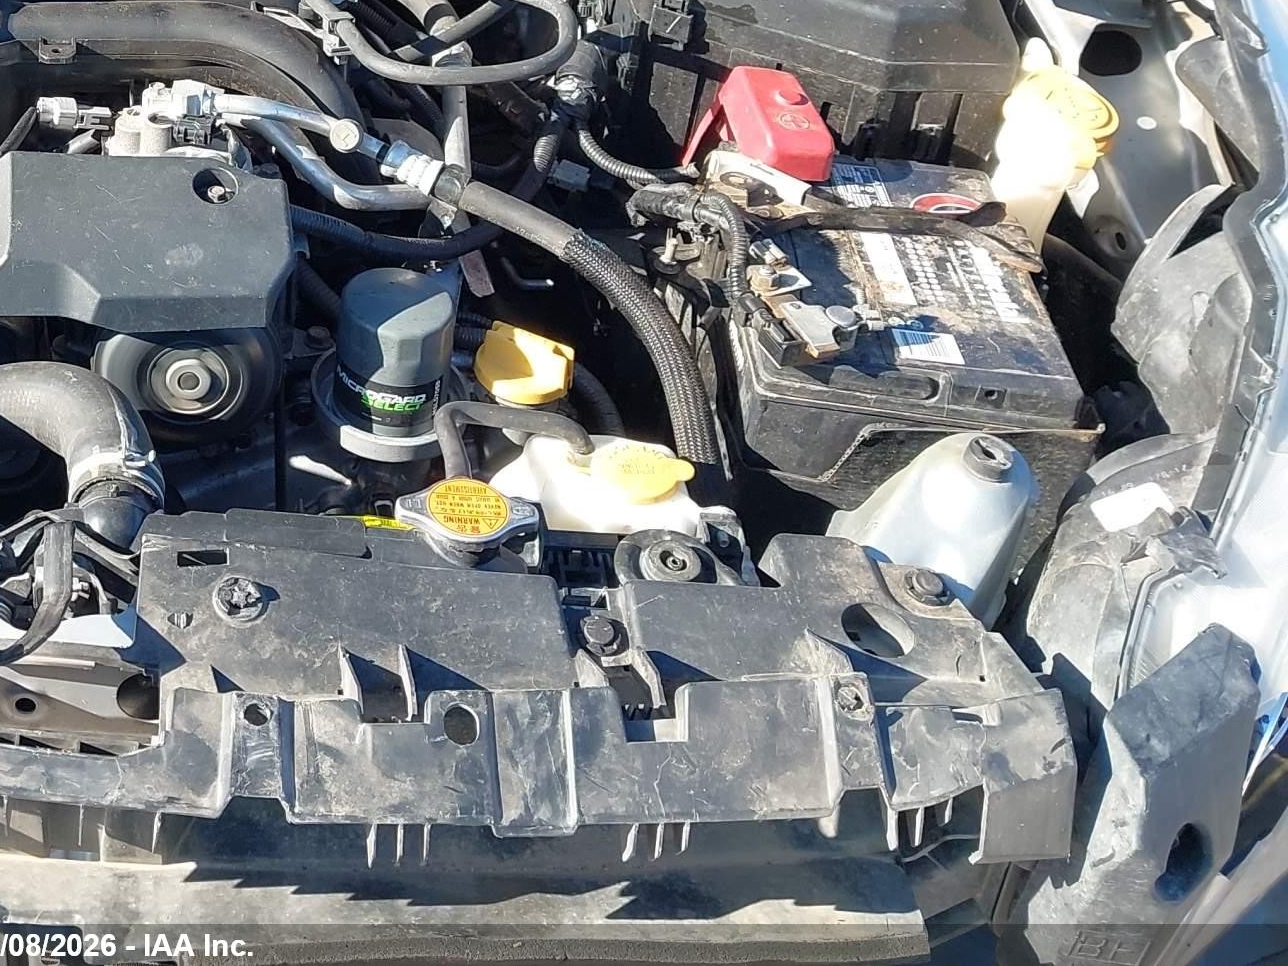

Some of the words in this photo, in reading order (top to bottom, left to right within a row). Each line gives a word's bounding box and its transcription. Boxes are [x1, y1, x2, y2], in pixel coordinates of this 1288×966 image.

[336, 364, 427, 404] MICROGARD
[360, 397, 423, 412] SELECT
[443, 515, 480, 524] WARNING
